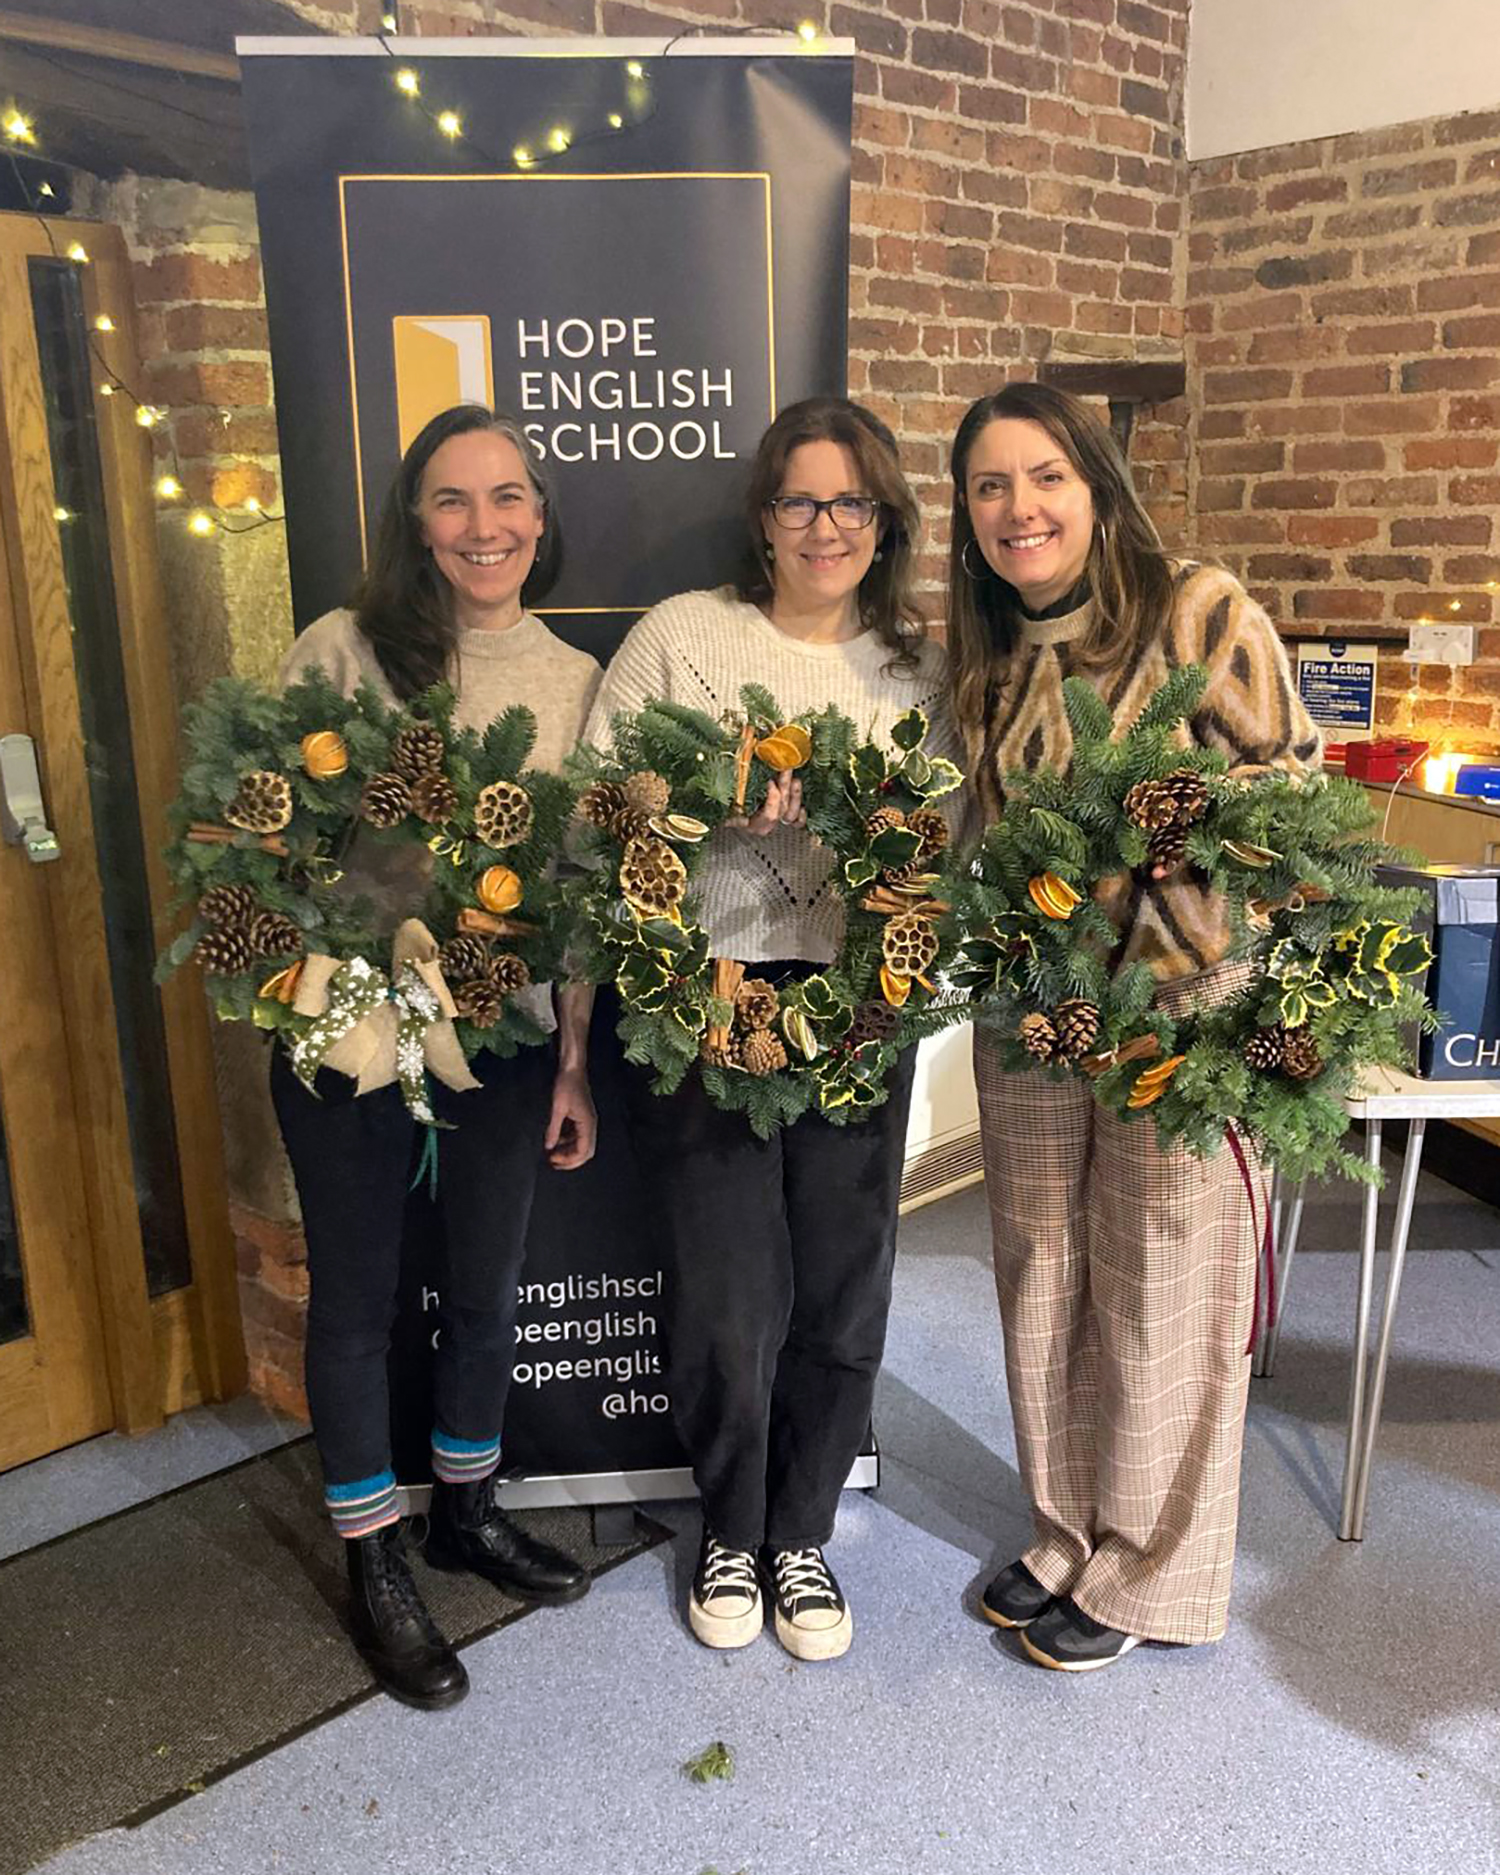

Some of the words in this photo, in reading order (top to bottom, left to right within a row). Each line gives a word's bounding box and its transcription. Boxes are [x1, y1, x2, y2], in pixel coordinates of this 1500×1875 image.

[518, 318, 657, 358] HOPE
[520, 368, 732, 410] ENGLISH
[523, 420, 736, 462] SCHOOL
[1303, 662, 1327, 674] Fire
[1330, 662, 1371, 675] Action
[1445, 1034, 1500, 1067] CH
